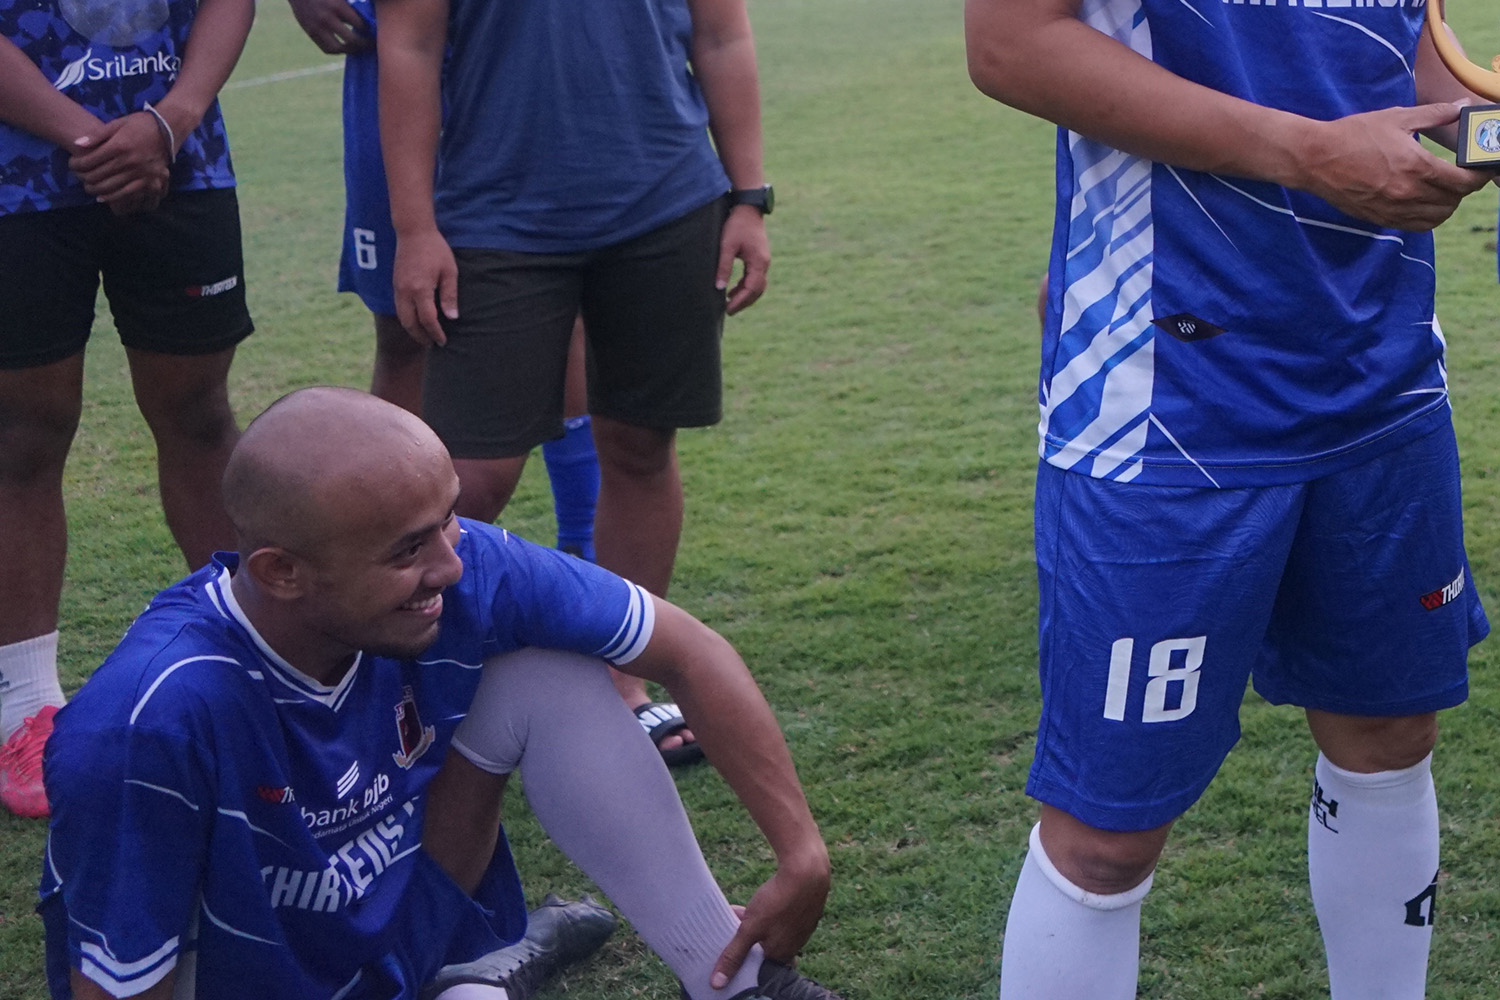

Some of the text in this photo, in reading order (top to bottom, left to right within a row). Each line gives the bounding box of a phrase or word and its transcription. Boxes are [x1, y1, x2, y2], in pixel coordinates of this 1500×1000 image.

[353, 227, 377, 271] 6
[1103, 636, 1207, 723] 18
[301, 799, 359, 828] bank
[364, 773, 390, 808] bjb
